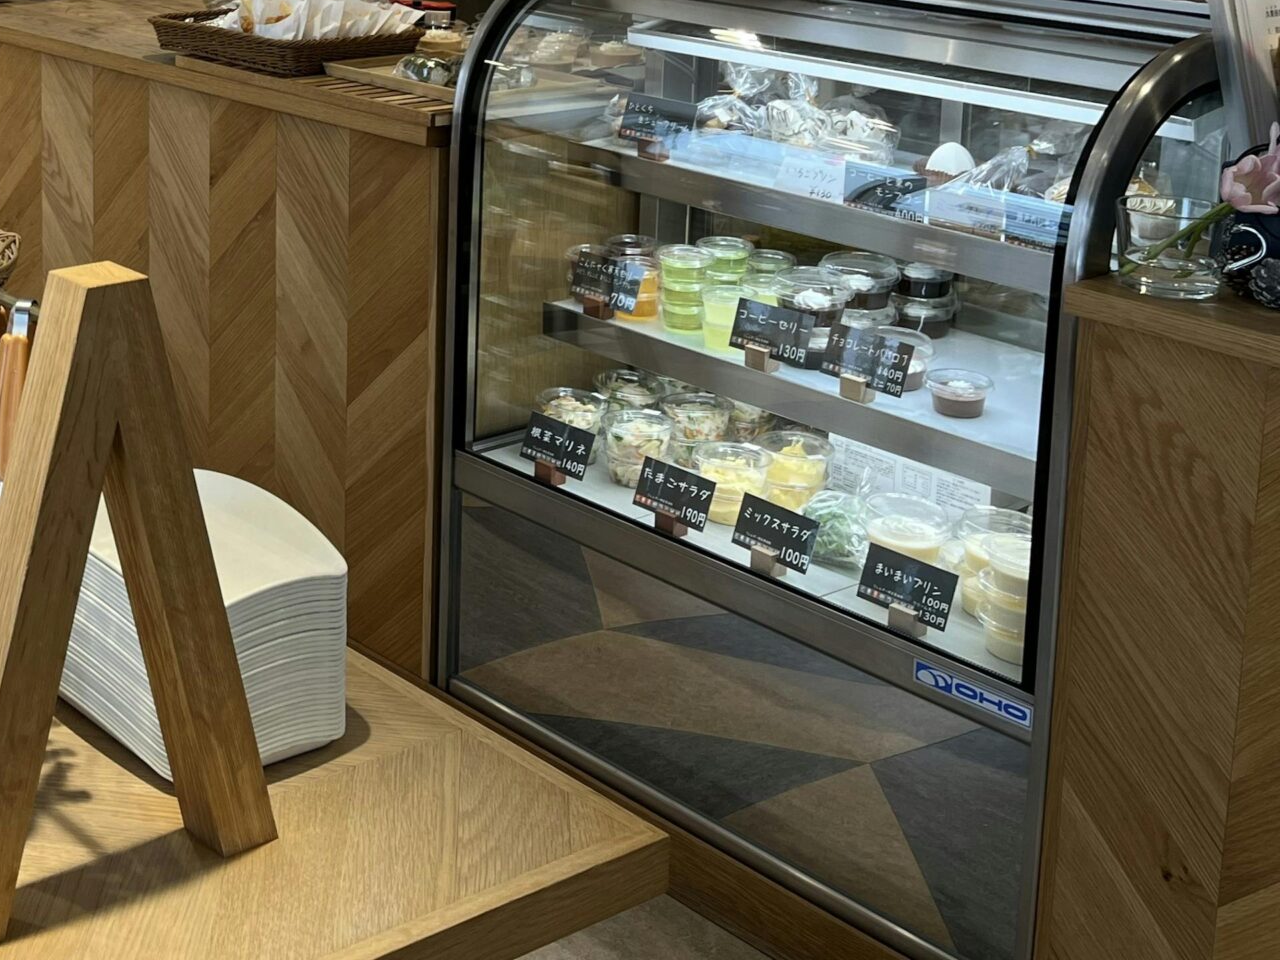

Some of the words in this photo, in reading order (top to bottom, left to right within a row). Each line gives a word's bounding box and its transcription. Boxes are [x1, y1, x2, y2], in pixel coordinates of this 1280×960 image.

[610, 292, 637, 311] 70円
[739, 308, 809, 335] コーヒーゼリー
[778, 343, 807, 363] 130円
[877, 366, 904, 382] 140円
[530, 426, 587, 456] 根菜マリネ
[561, 457, 586, 476] 140円
[643, 467, 712, 501] たまごサラダ
[680, 505, 707, 528] 190円
[743, 507, 812, 542] ミックスサラダ
[779, 546, 810, 570] 100円
[874, 562, 942, 595] まいまいプリン
[921, 595, 950, 614] 100円
[918, 609, 946, 628] 130円
[954, 681, 1028, 722] OHO
